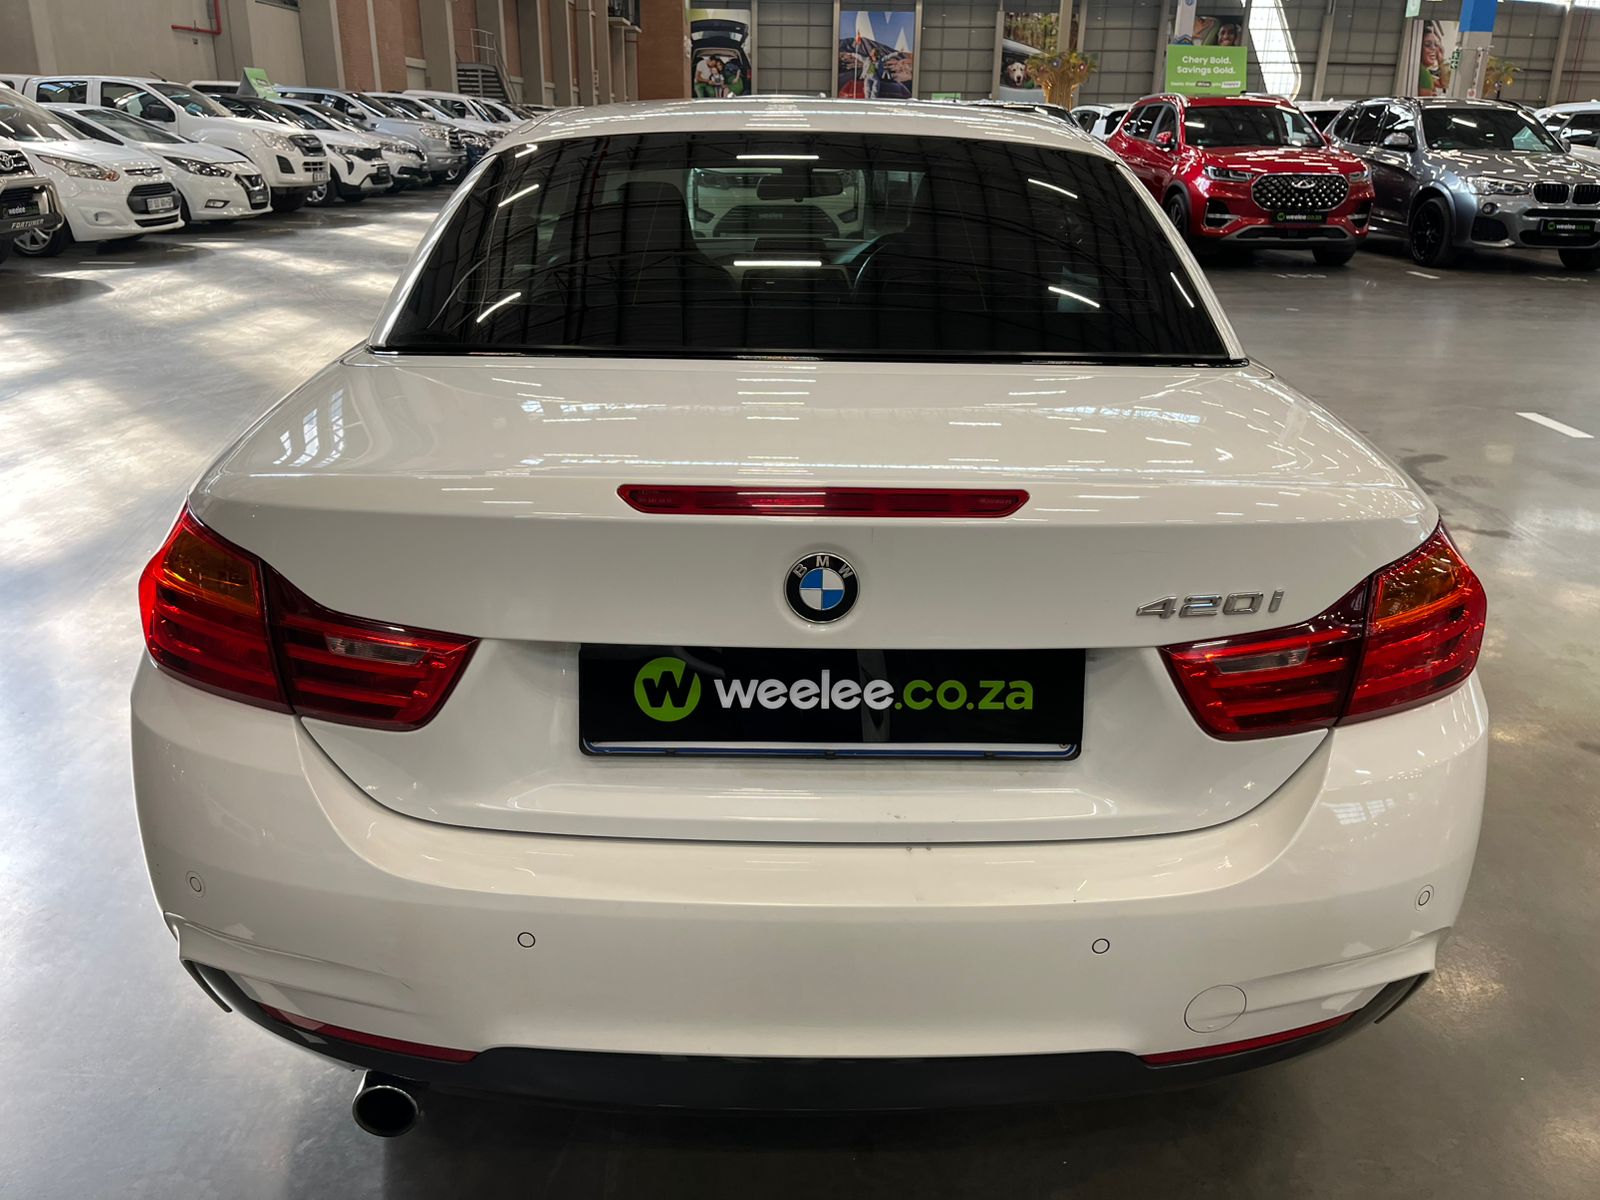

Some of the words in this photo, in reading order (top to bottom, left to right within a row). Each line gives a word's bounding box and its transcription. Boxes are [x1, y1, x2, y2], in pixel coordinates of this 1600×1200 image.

[1182, 55, 1208, 65] Chery
[1210, 56, 1231, 64] Bold.
[1177, 65, 1211, 76] Savings
[1212, 66, 1236, 74] Gold.
[792, 555, 854, 579] BMW
[713, 669, 1034, 711] weelee.co.za
